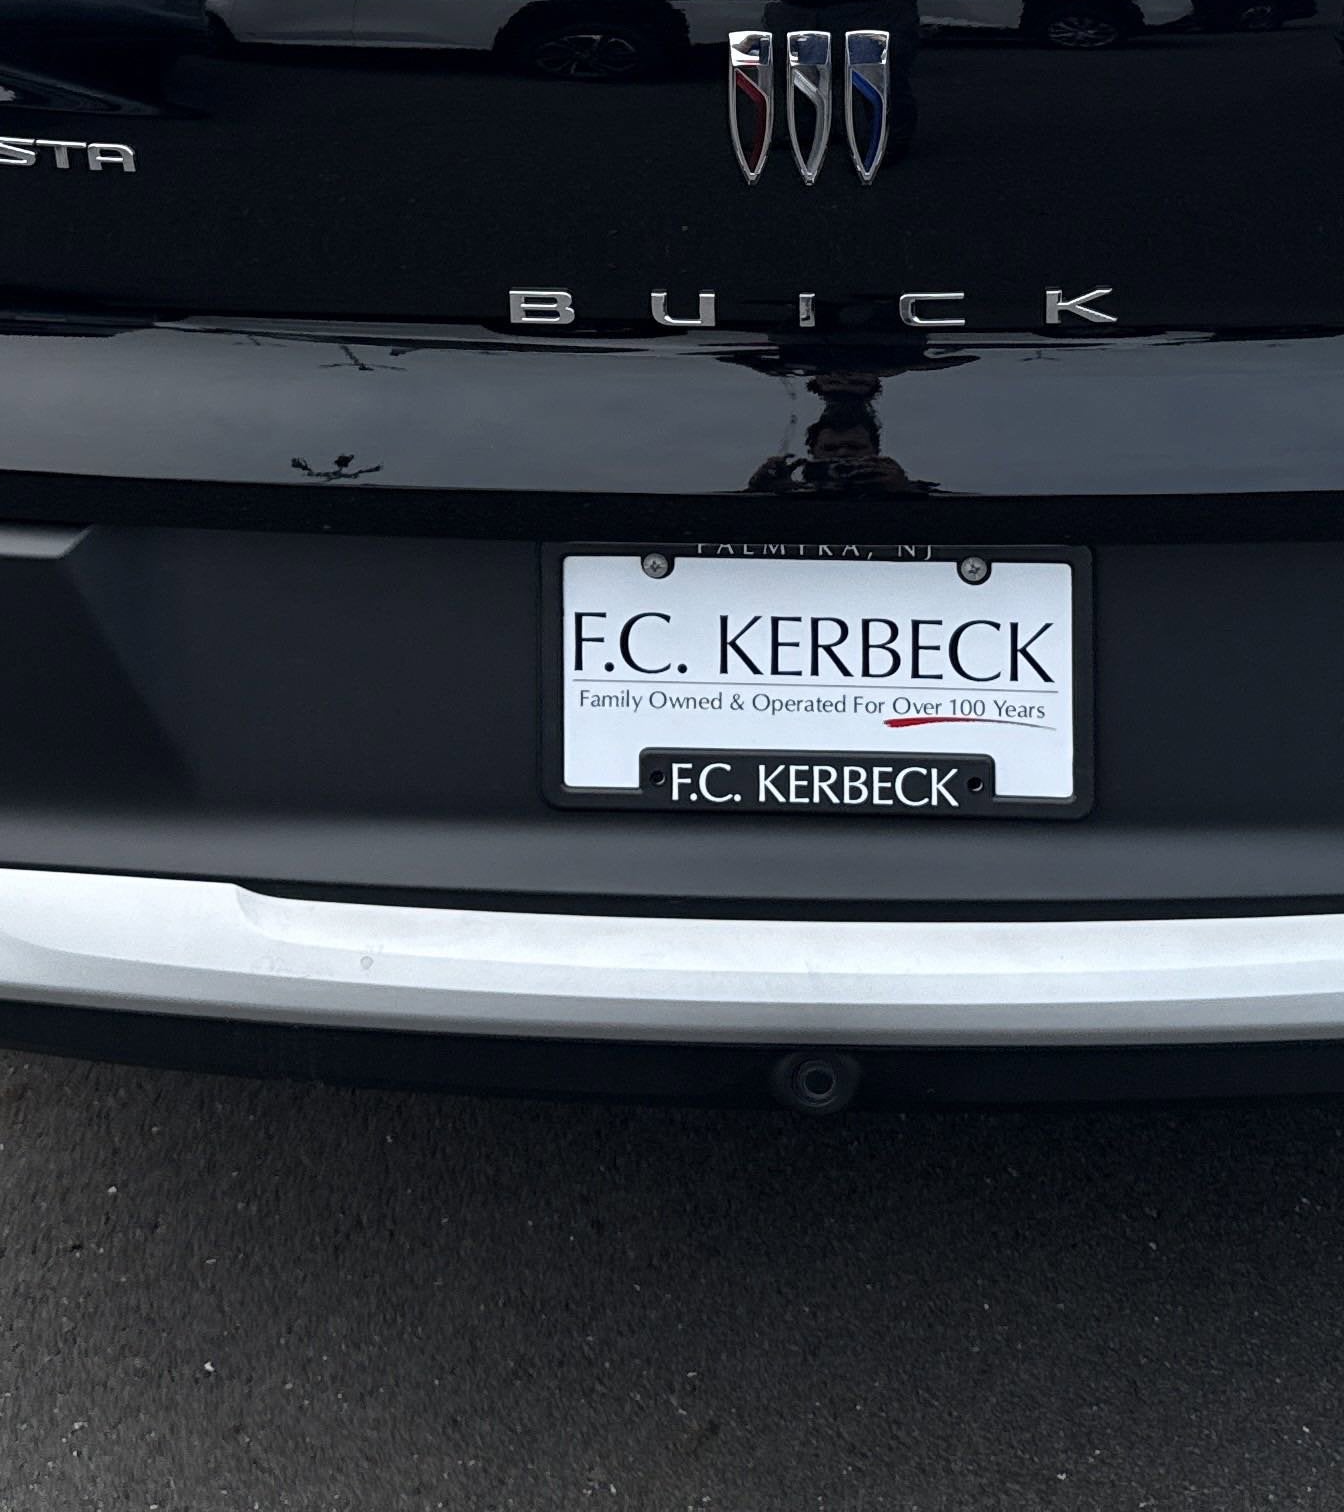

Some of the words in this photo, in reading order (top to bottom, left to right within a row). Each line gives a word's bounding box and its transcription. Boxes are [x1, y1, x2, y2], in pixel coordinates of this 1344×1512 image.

[508, 286, 1118, 327] BUICK
[573, 611, 688, 674] F.C.
[719, 614, 1055, 684] KERBECK
[580, 689, 642, 713] Family
[649, 690, 723, 710] Owned
[730, 693, 744, 711] &
[752, 693, 846, 715] Operated
[854, 696, 885, 714] For
[892, 696, 942, 715] Over
[950, 698, 986, 717] 100
[993, 699, 1045, 719] Years
[671, 763, 742, 803] F.C.
[758, 764, 960, 807] KERBECK
